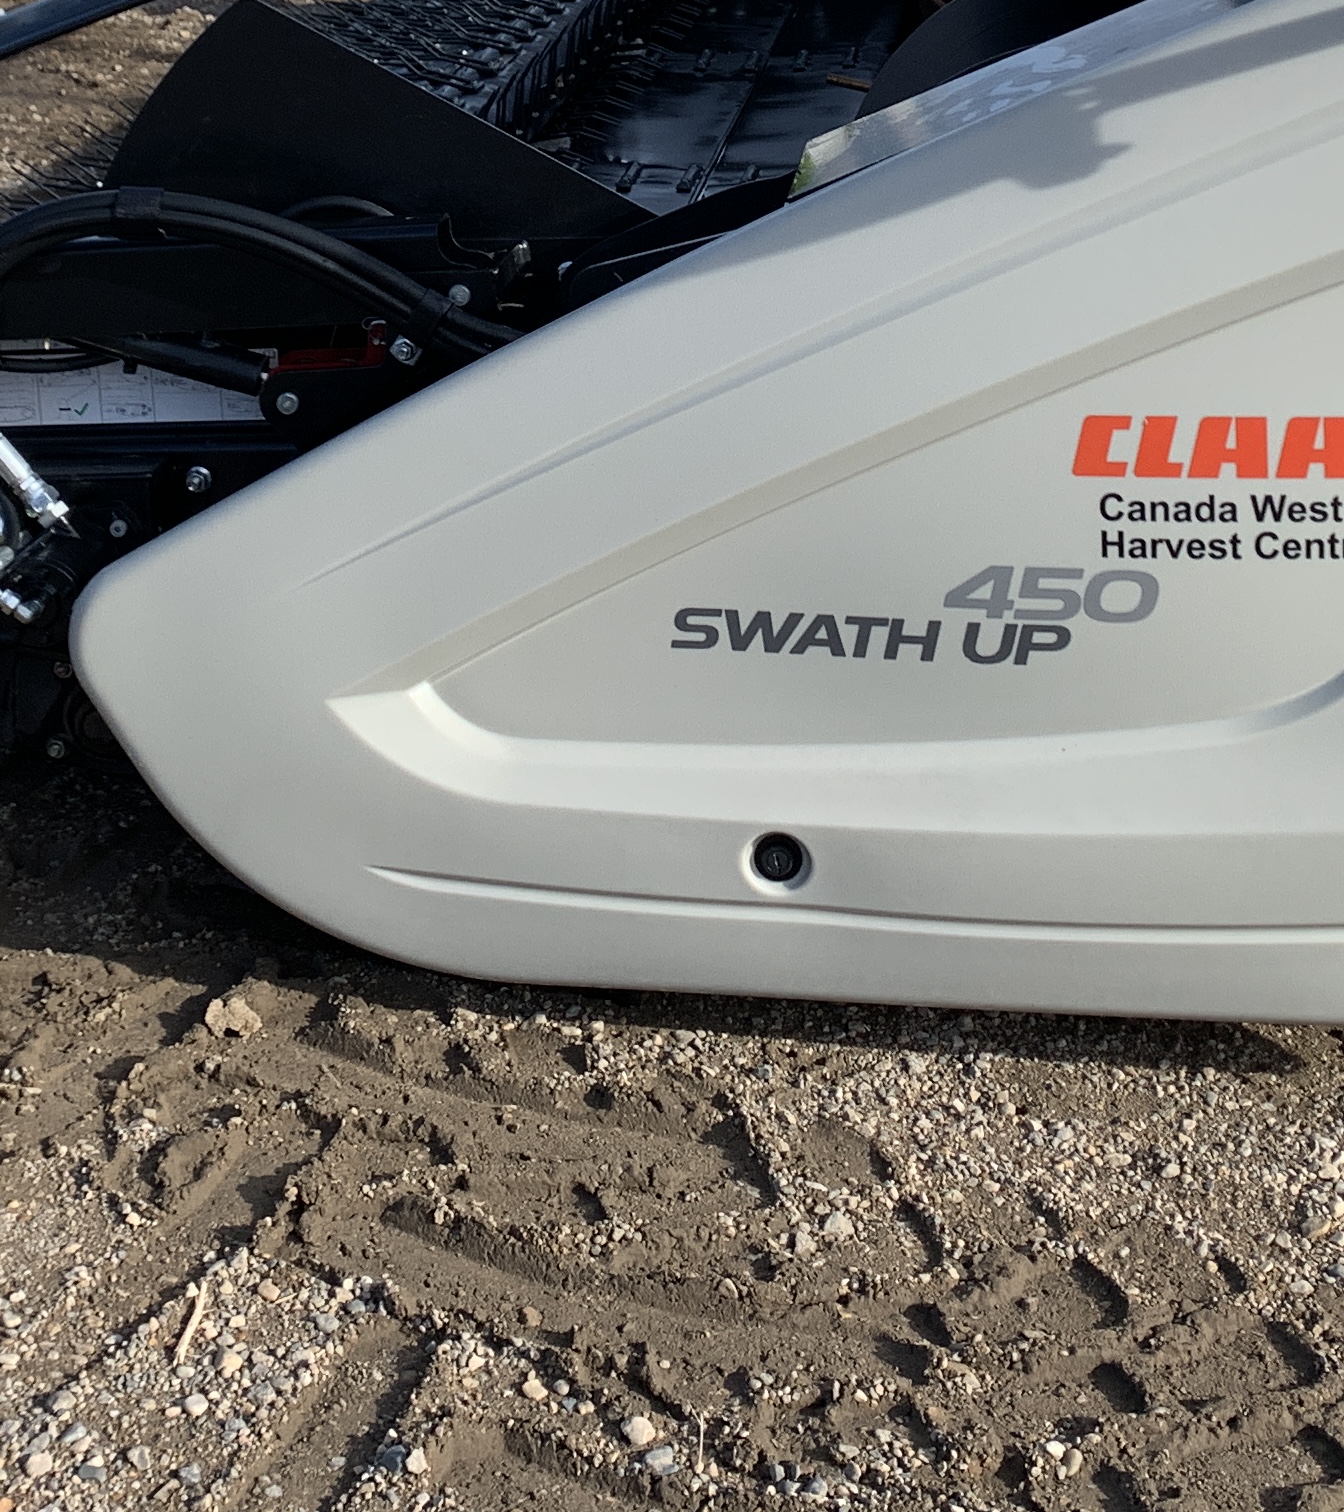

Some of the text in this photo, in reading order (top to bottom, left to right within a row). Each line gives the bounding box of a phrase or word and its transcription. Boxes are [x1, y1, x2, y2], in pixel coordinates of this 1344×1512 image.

[1099, 493, 1343, 523] Canada West
[1101, 531, 1242, 559] Harvest
[943, 565, 1160, 624] 450
[670, 607, 1072, 666] SWATH UP
